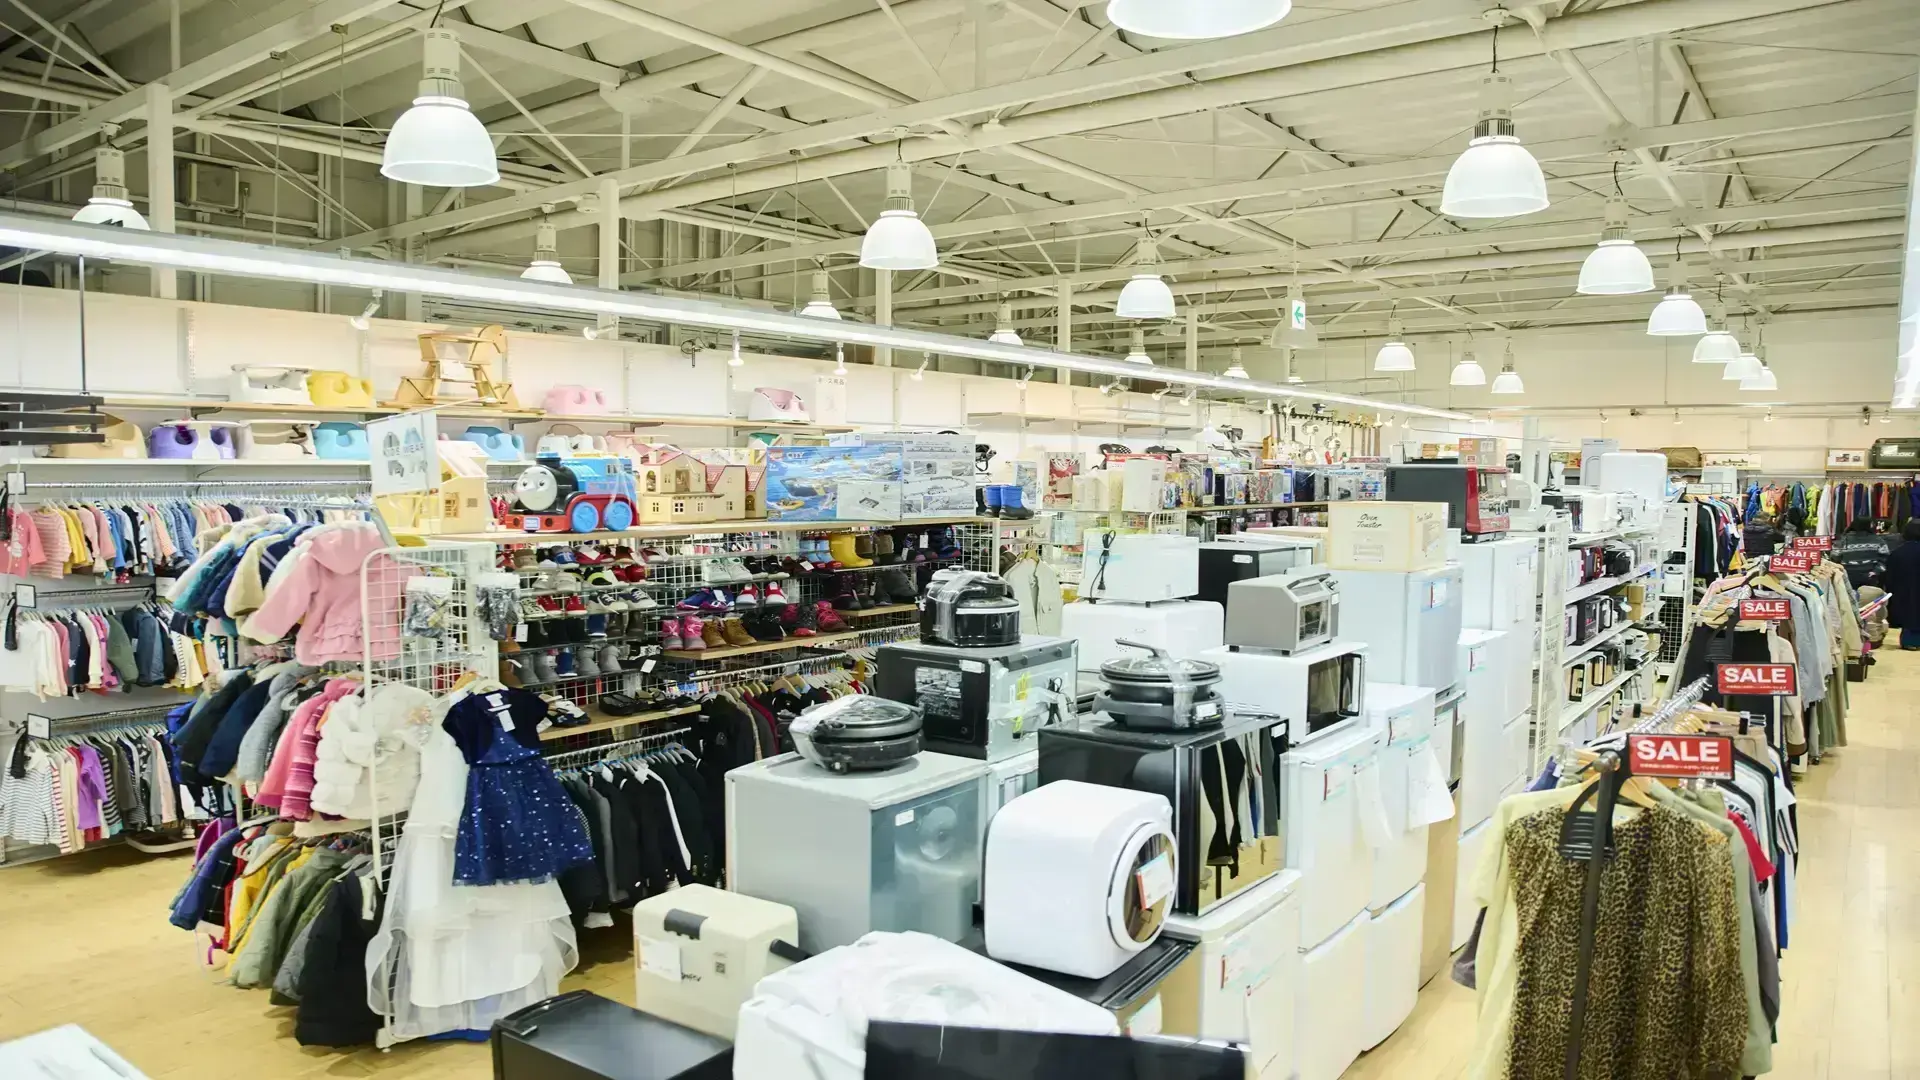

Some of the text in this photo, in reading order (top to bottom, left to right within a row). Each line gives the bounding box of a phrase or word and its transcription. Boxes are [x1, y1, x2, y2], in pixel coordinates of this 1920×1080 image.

[786, 451, 804, 460] CITY
[1360, 513, 1378, 521] Oven
[1797, 538, 1828, 547] SALE
[1773, 557, 1807, 568] SALE
[1744, 602, 1786, 613] SALE
[1724, 667, 1787, 684] SALE
[1636, 739, 1720, 762] SALE
